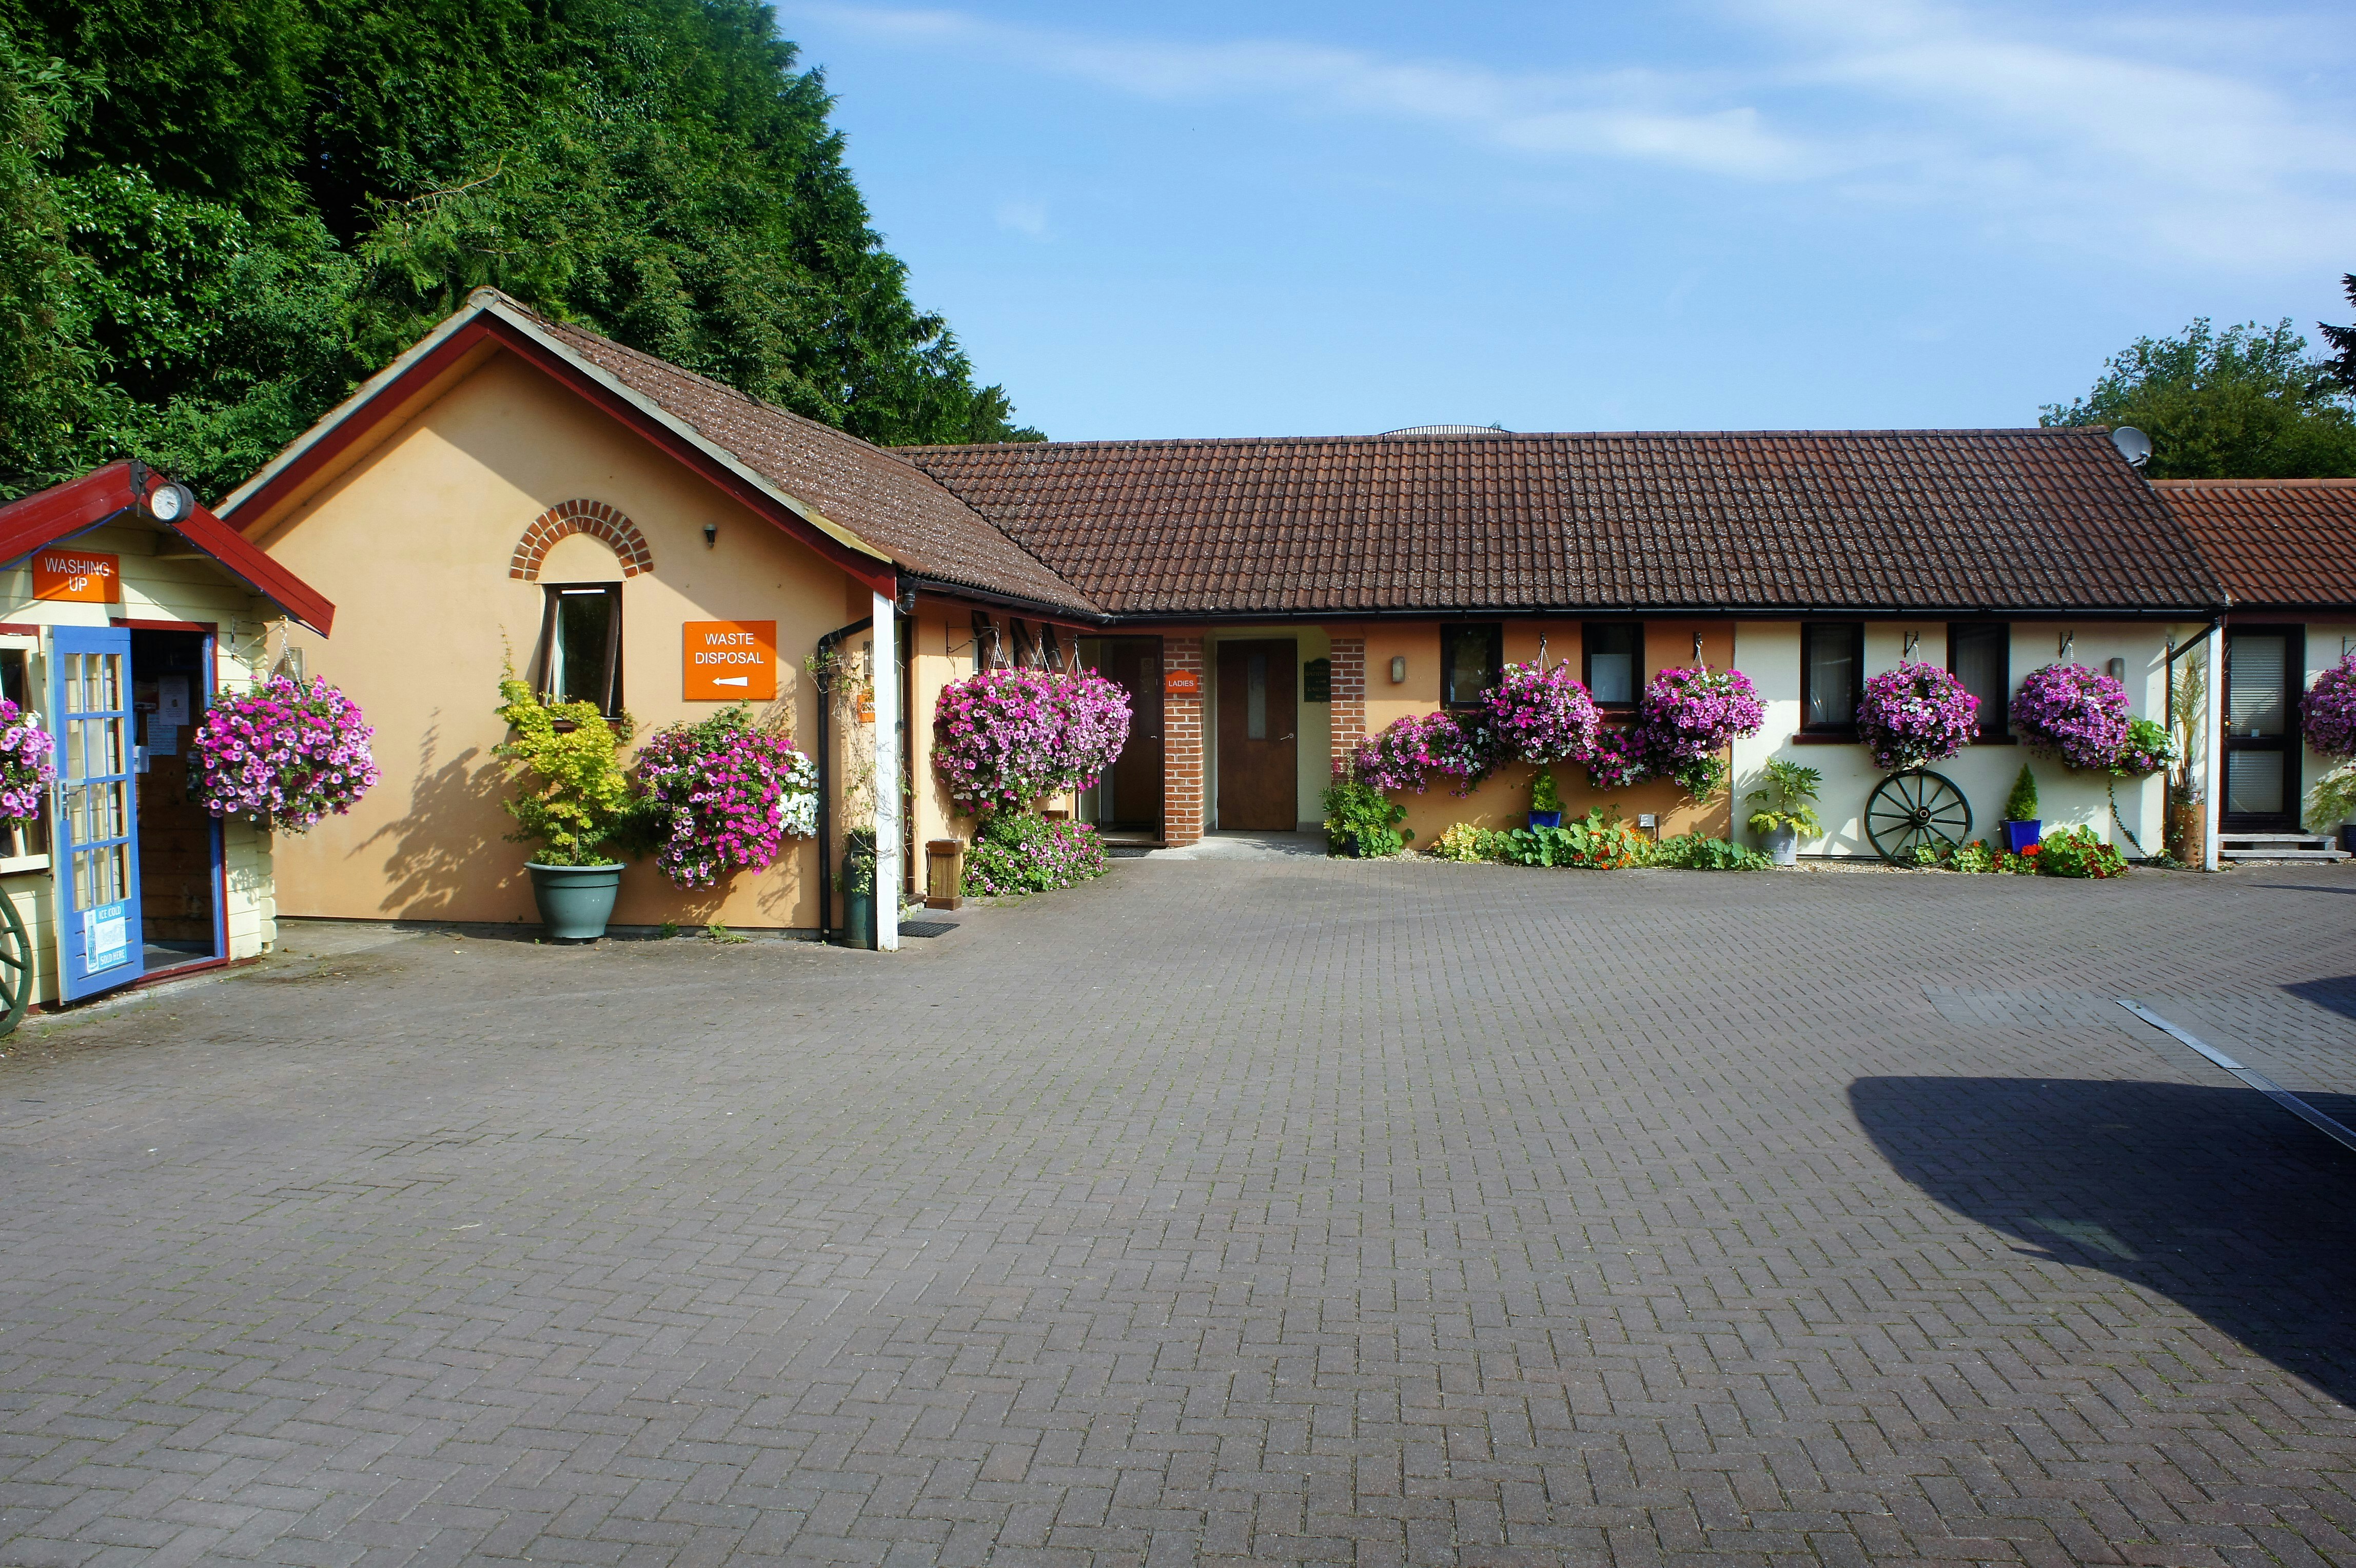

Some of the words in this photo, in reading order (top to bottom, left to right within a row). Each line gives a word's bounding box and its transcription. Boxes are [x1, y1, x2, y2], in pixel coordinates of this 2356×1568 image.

[45, 557, 110, 577] WASHING
[69, 576, 88, 592] UP
[705, 633, 754, 645] WASTE
[695, 652, 764, 664] DISPOSAL
[99, 909, 107, 919] ICE
[108, 906, 122, 917] COLD
[100, 953, 112, 965] SOLD
[113, 949, 125, 961] HERE
